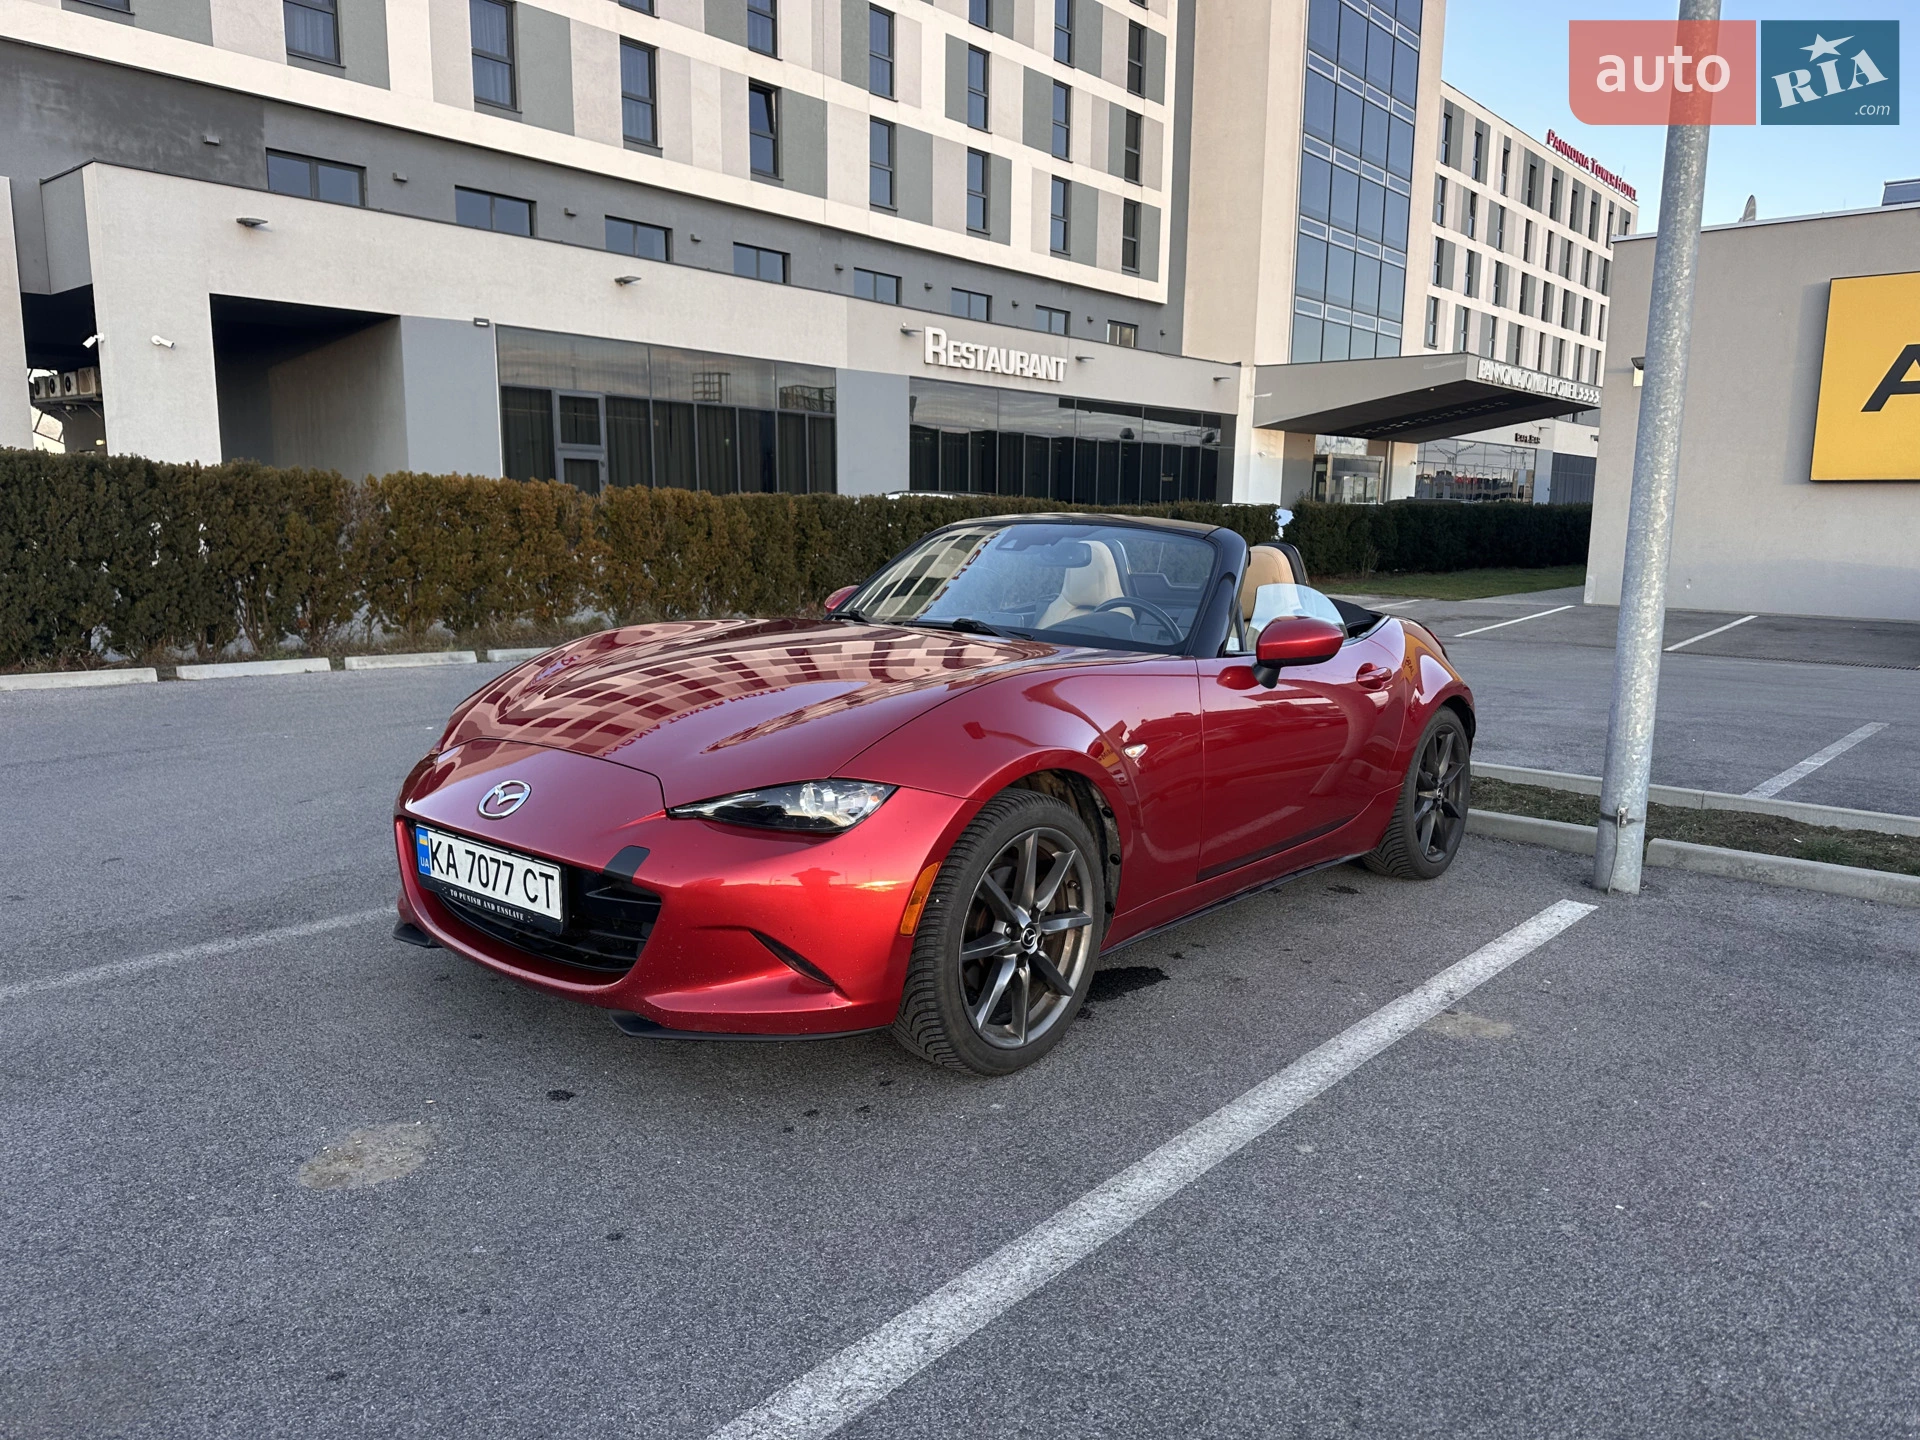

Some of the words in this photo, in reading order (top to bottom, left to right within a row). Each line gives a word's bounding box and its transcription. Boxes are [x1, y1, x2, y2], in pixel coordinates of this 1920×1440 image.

[1546, 129, 1590, 171] PANNONIA
[924, 326, 1068, 382] RESTAURANT
[420, 857, 430, 869] UA
[429, 837, 459, 880] KA
[464, 849, 514, 896] 7077
[523, 868, 555, 909] CT
[450, 889, 458, 898] TO
[459, 892, 481, 906] PUNISH
[483, 901, 495, 911] AND
